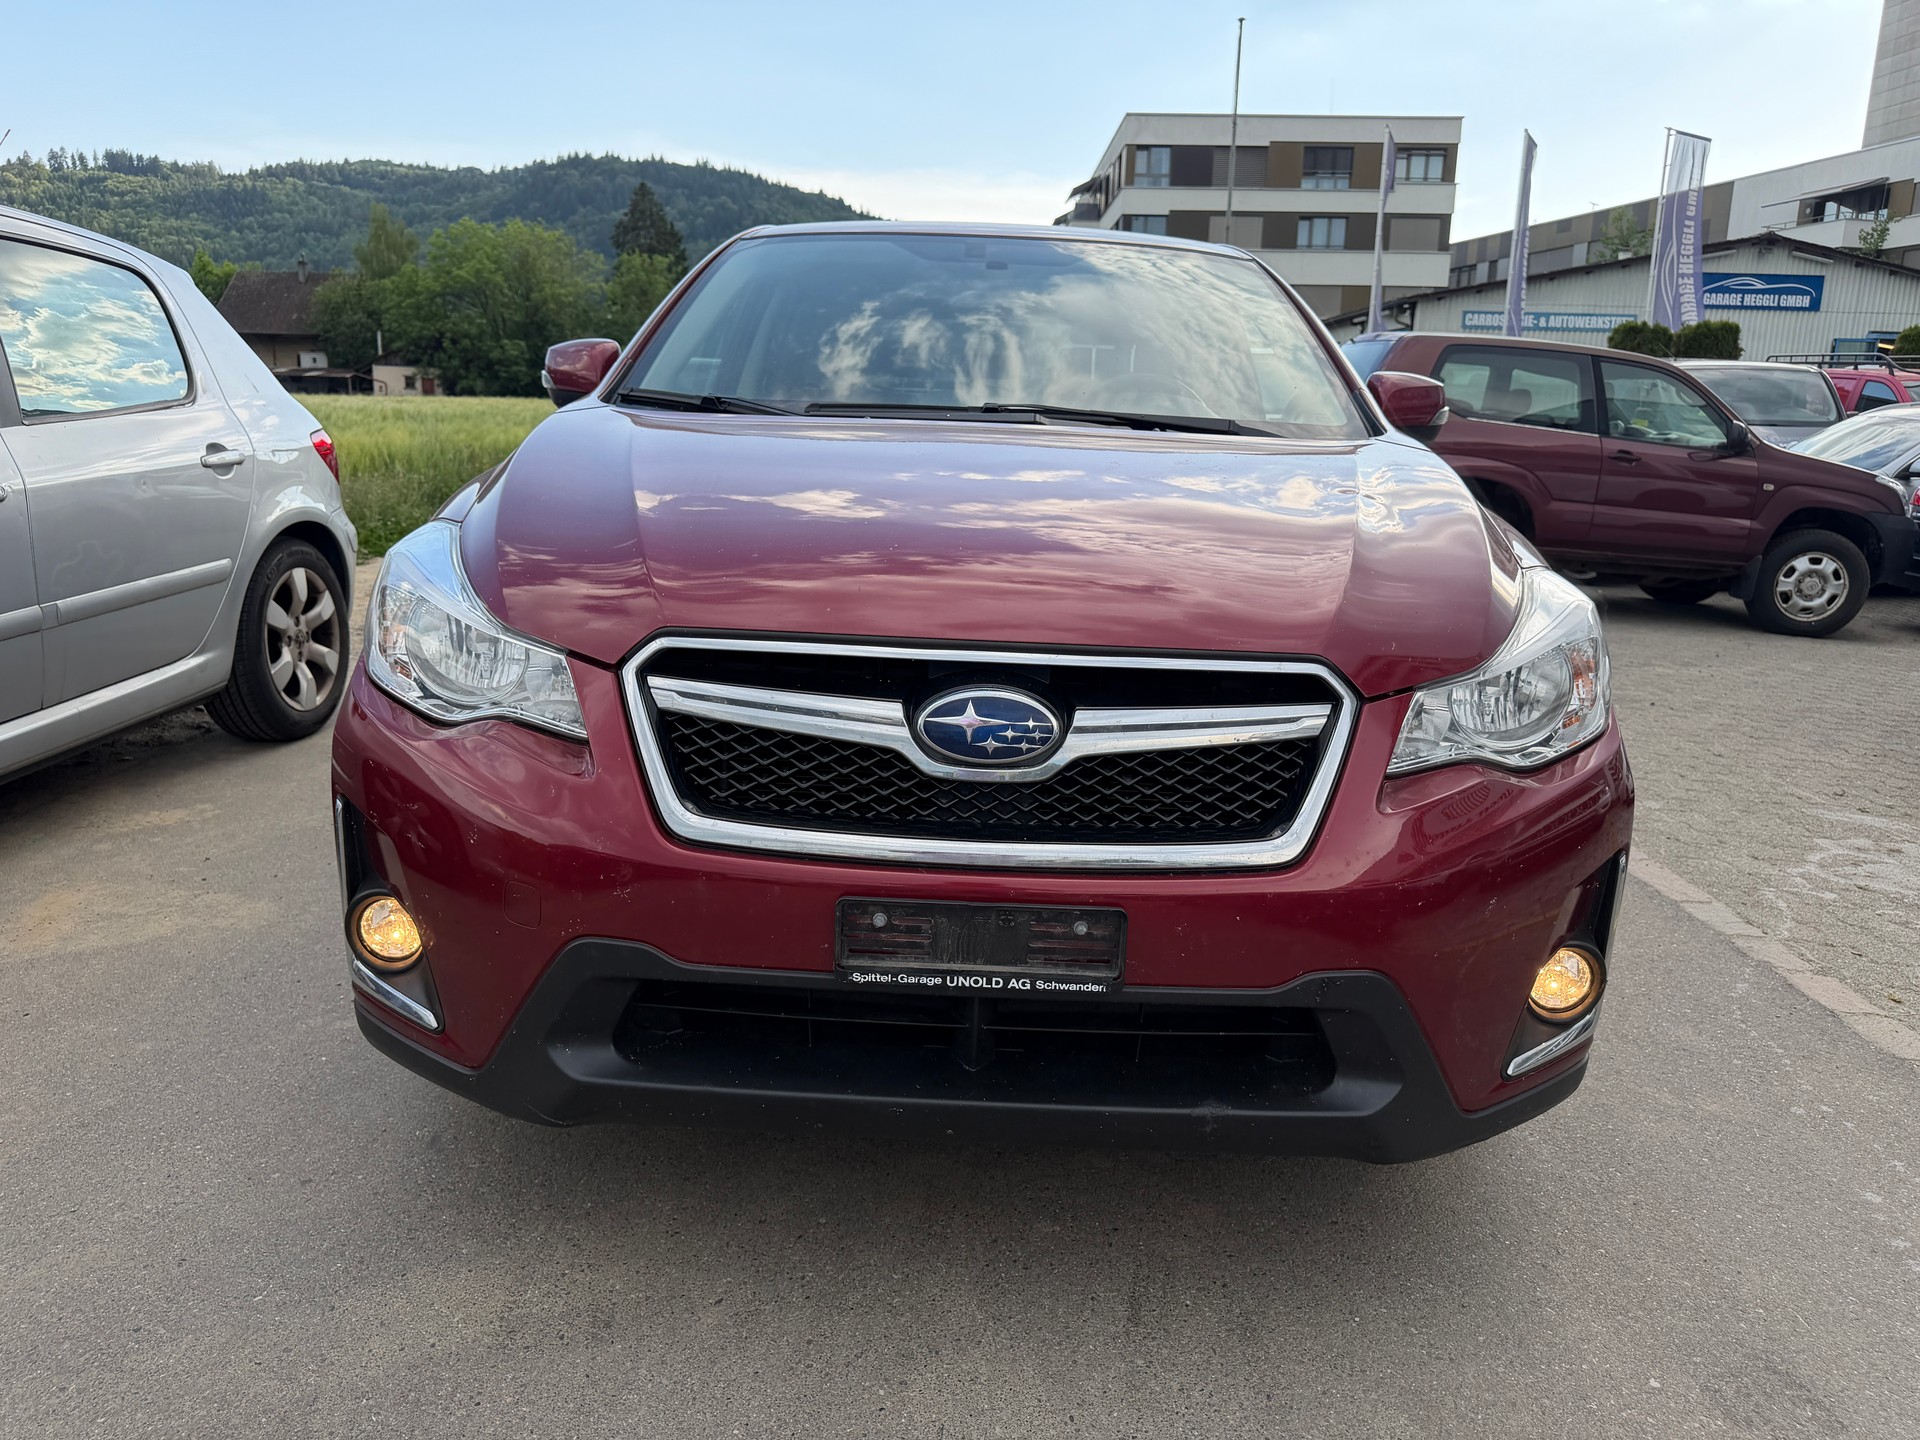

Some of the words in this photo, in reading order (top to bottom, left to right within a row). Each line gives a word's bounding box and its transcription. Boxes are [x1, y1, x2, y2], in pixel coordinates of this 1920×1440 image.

[1678, 219, 1696, 274] HEGGLI
[1703, 292, 1742, 305] GARAGE
[1743, 293, 1778, 306] HEGGLI
[1779, 294, 1811, 307] GMBH
[1538, 316, 1548, 327] &
[852, 972, 942, 986] Spittel-Garage
[946, 976, 1003, 988] UNOLD
[1007, 978, 1031, 990] AG
